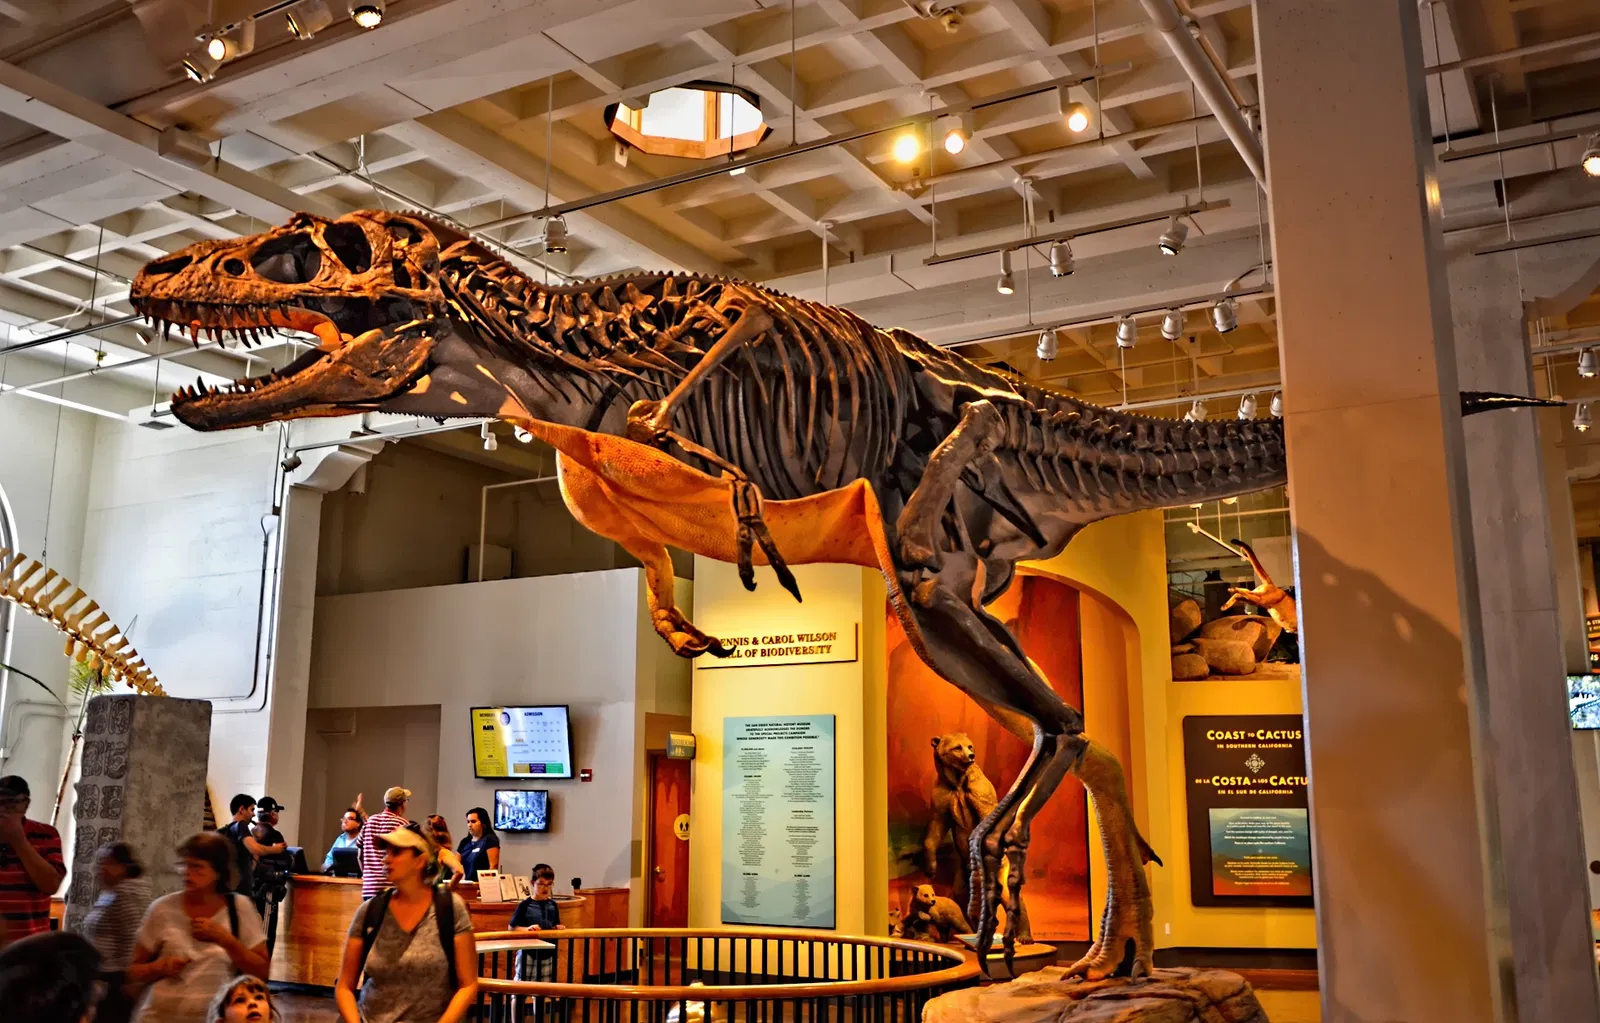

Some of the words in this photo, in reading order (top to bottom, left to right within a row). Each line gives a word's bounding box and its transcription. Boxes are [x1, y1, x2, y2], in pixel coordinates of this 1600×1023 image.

[720, 637, 750, 647] ENNIS
[751, 636, 759, 646] &
[761, 635, 795, 645] CAROL
[797, 632, 837, 643] WILSON
[744, 648, 758, 658] OF
[760, 645, 832, 657] BIODIVERSITY
[1206, 729, 1246, 740] COAST
[1256, 729, 1302, 740] CACTUS
[1211, 775, 1251, 787] COSTA
[1269, 775, 1309, 787] CACTU
